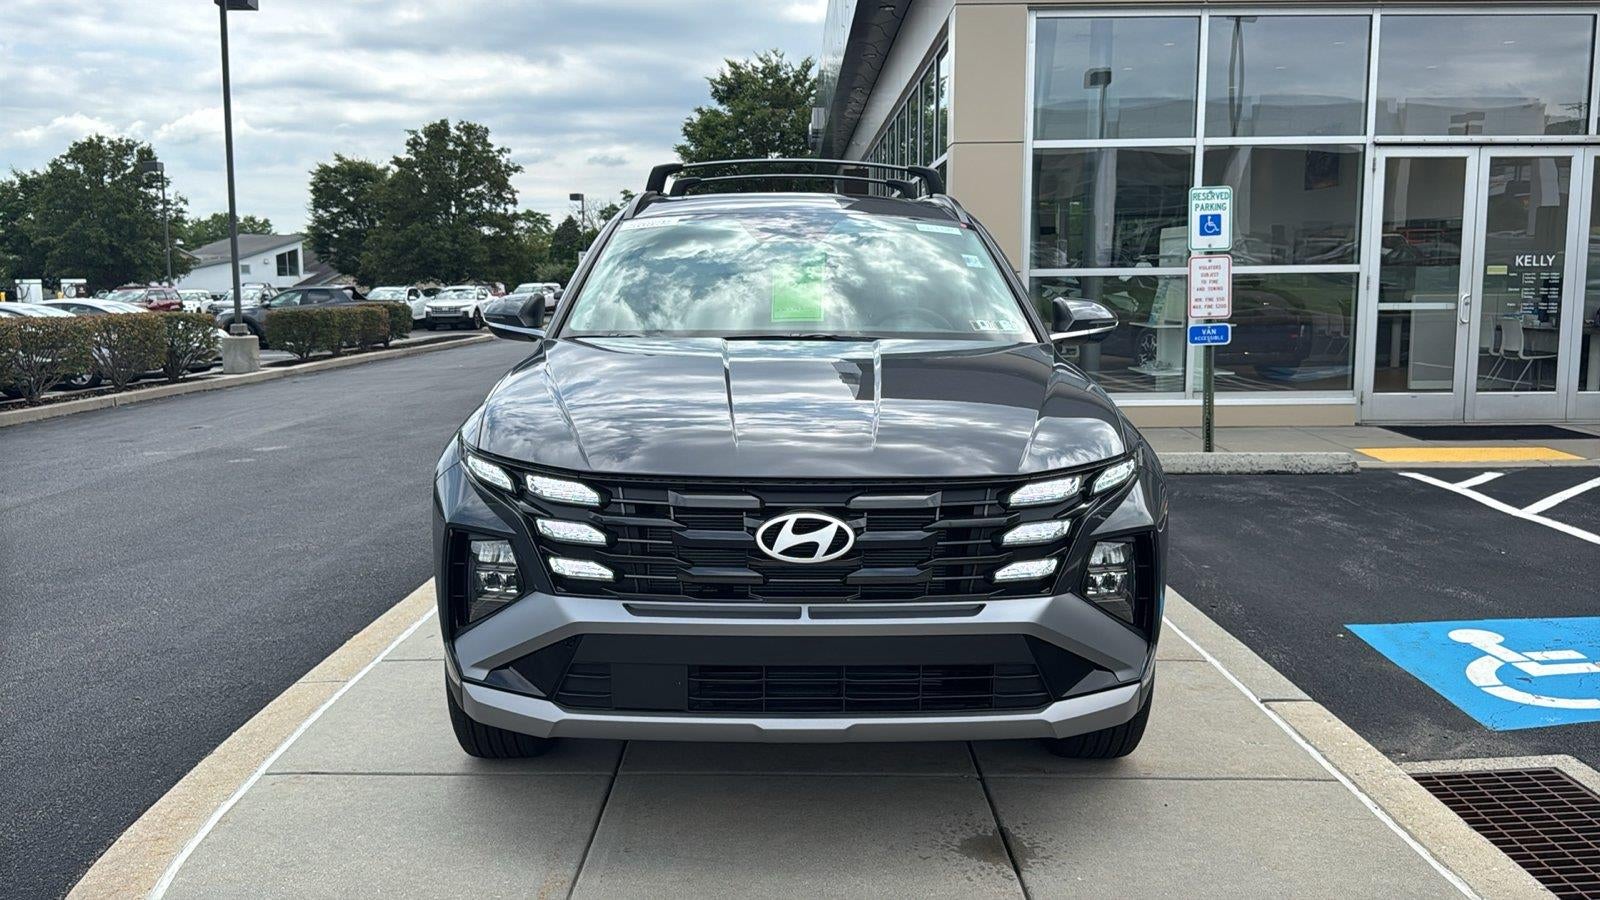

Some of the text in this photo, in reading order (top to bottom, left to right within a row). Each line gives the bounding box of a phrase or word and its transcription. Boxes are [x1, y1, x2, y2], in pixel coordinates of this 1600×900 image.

[1192, 191, 1231, 201] RESERVED
[1194, 202, 1227, 211] PARKING
[1515, 254, 1556, 267] KELLY
